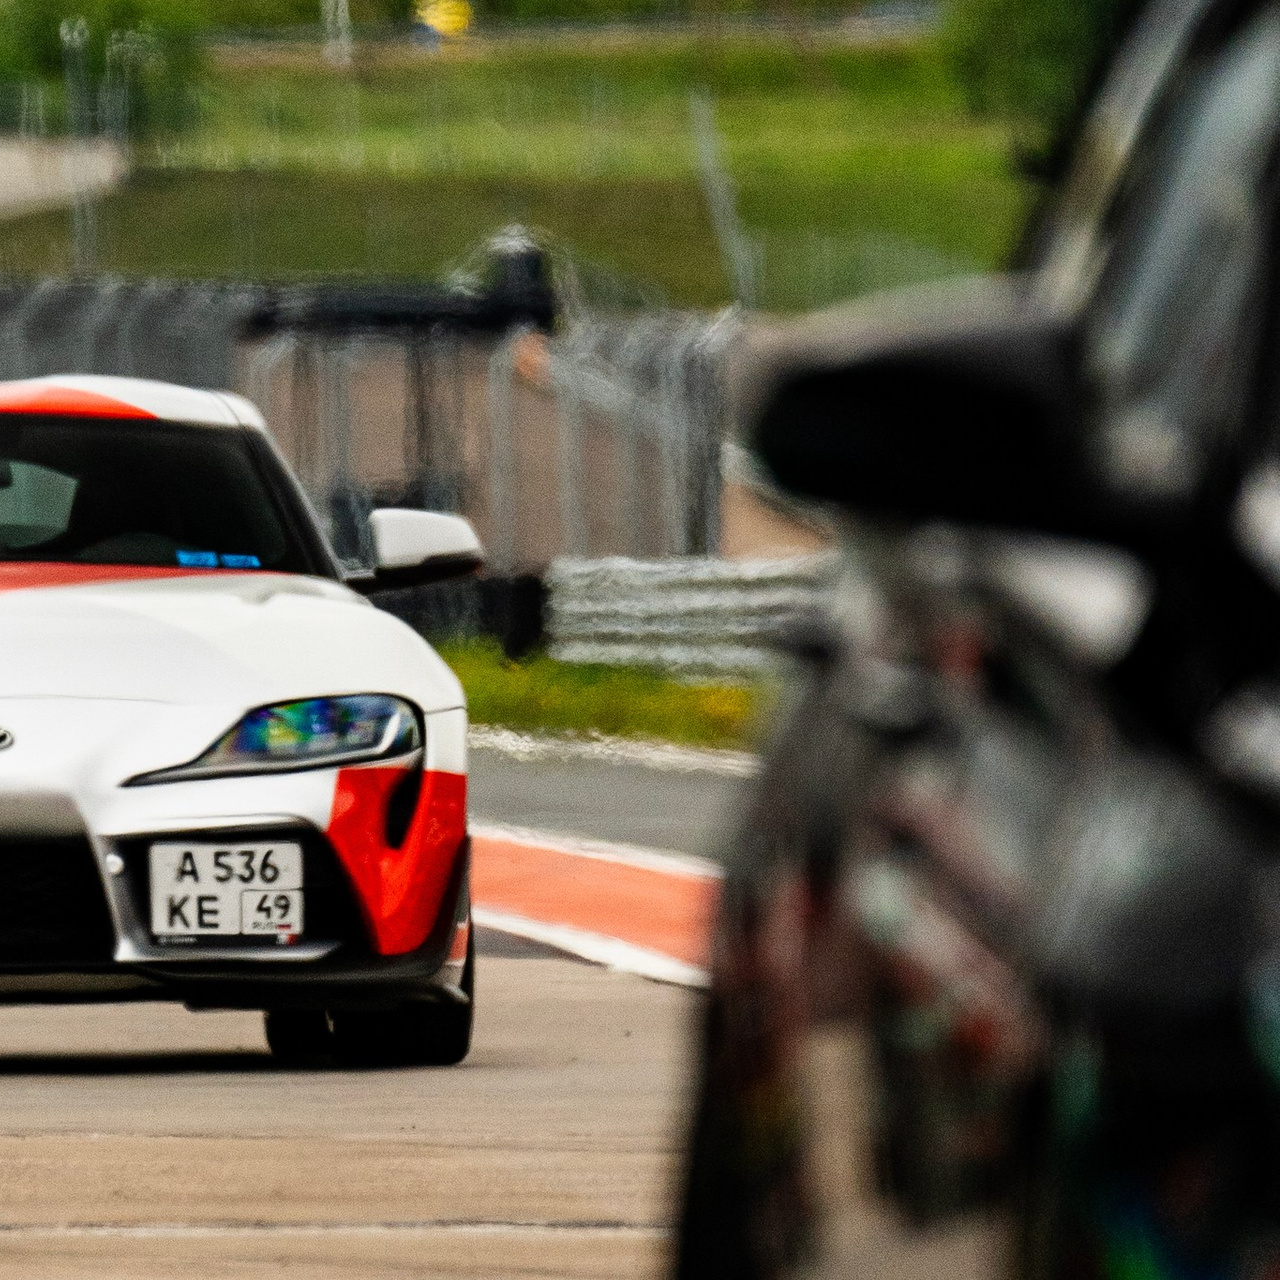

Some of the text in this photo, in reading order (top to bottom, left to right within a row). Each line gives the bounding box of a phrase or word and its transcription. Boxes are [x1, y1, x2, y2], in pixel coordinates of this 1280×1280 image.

[177, 850, 280, 883] A 536
[168, 895, 219, 929] KE
[256, 894, 291, 920] 49
